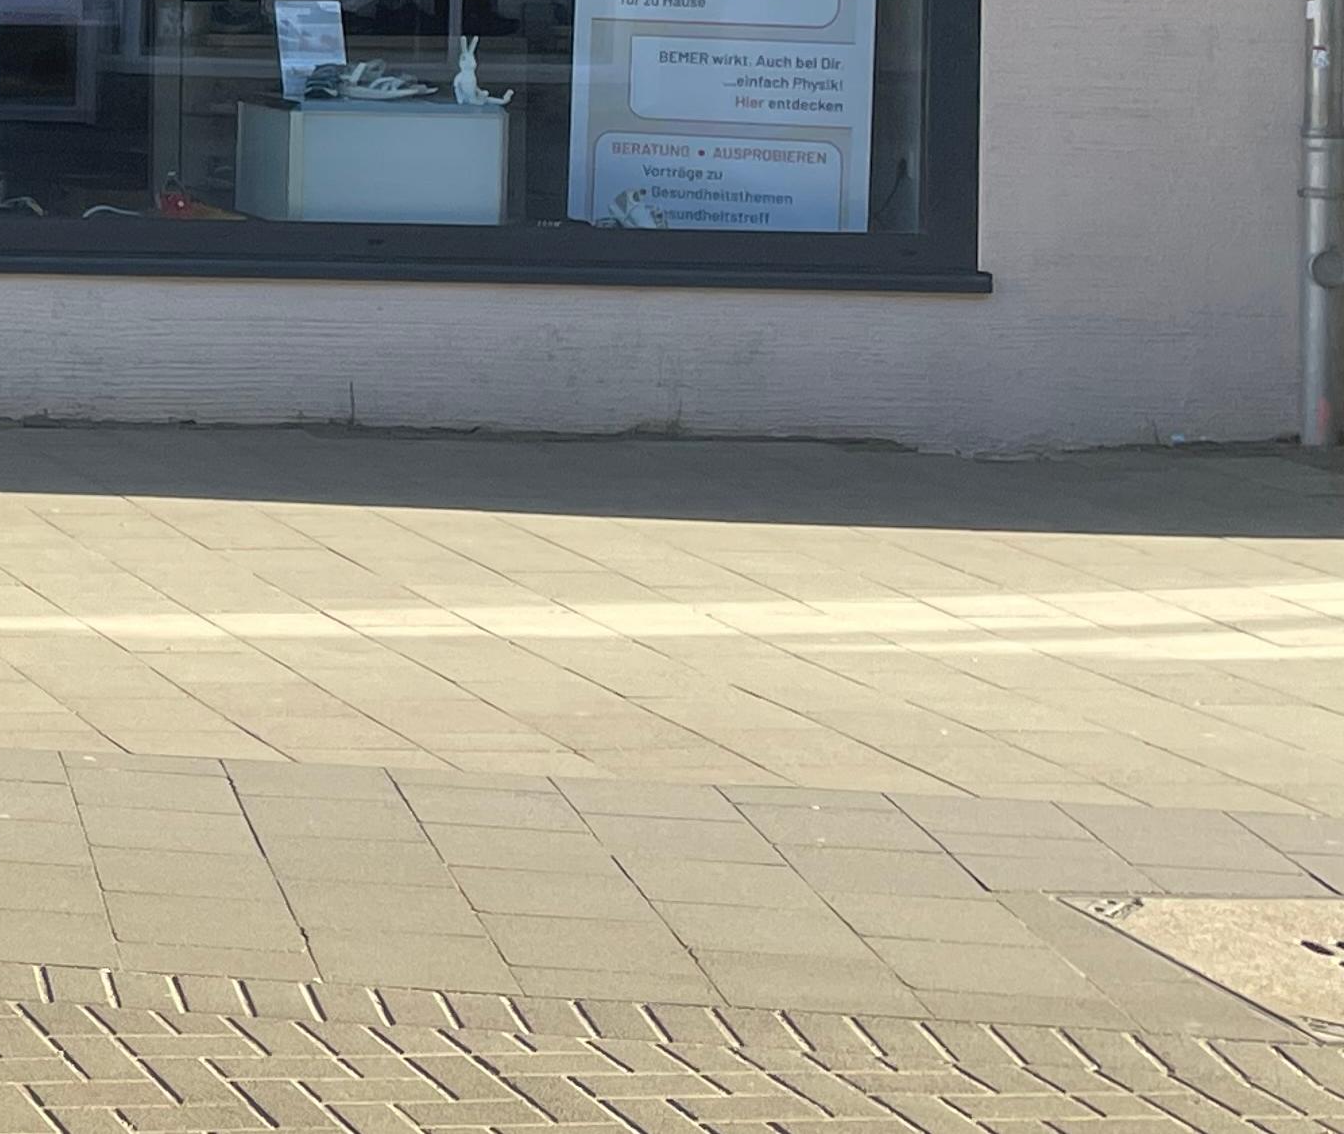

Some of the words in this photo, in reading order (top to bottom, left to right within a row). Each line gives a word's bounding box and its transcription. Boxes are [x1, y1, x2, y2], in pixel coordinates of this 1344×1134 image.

[659, 51, 709, 65] BEMER
[756, 55, 792, 68] Auch
[796, 56, 817, 70] bei
[735, 96, 764, 108] Hier
[768, 97, 843, 112] entdecken
[612, 142, 690, 158] BERATUNG
[713, 147, 827, 164] AUSPROBIEREN
[642, 164, 703, 181] Vorträge
[707, 169, 723, 181] zu
[651, 186, 793, 205] Gesundheitsthemen
